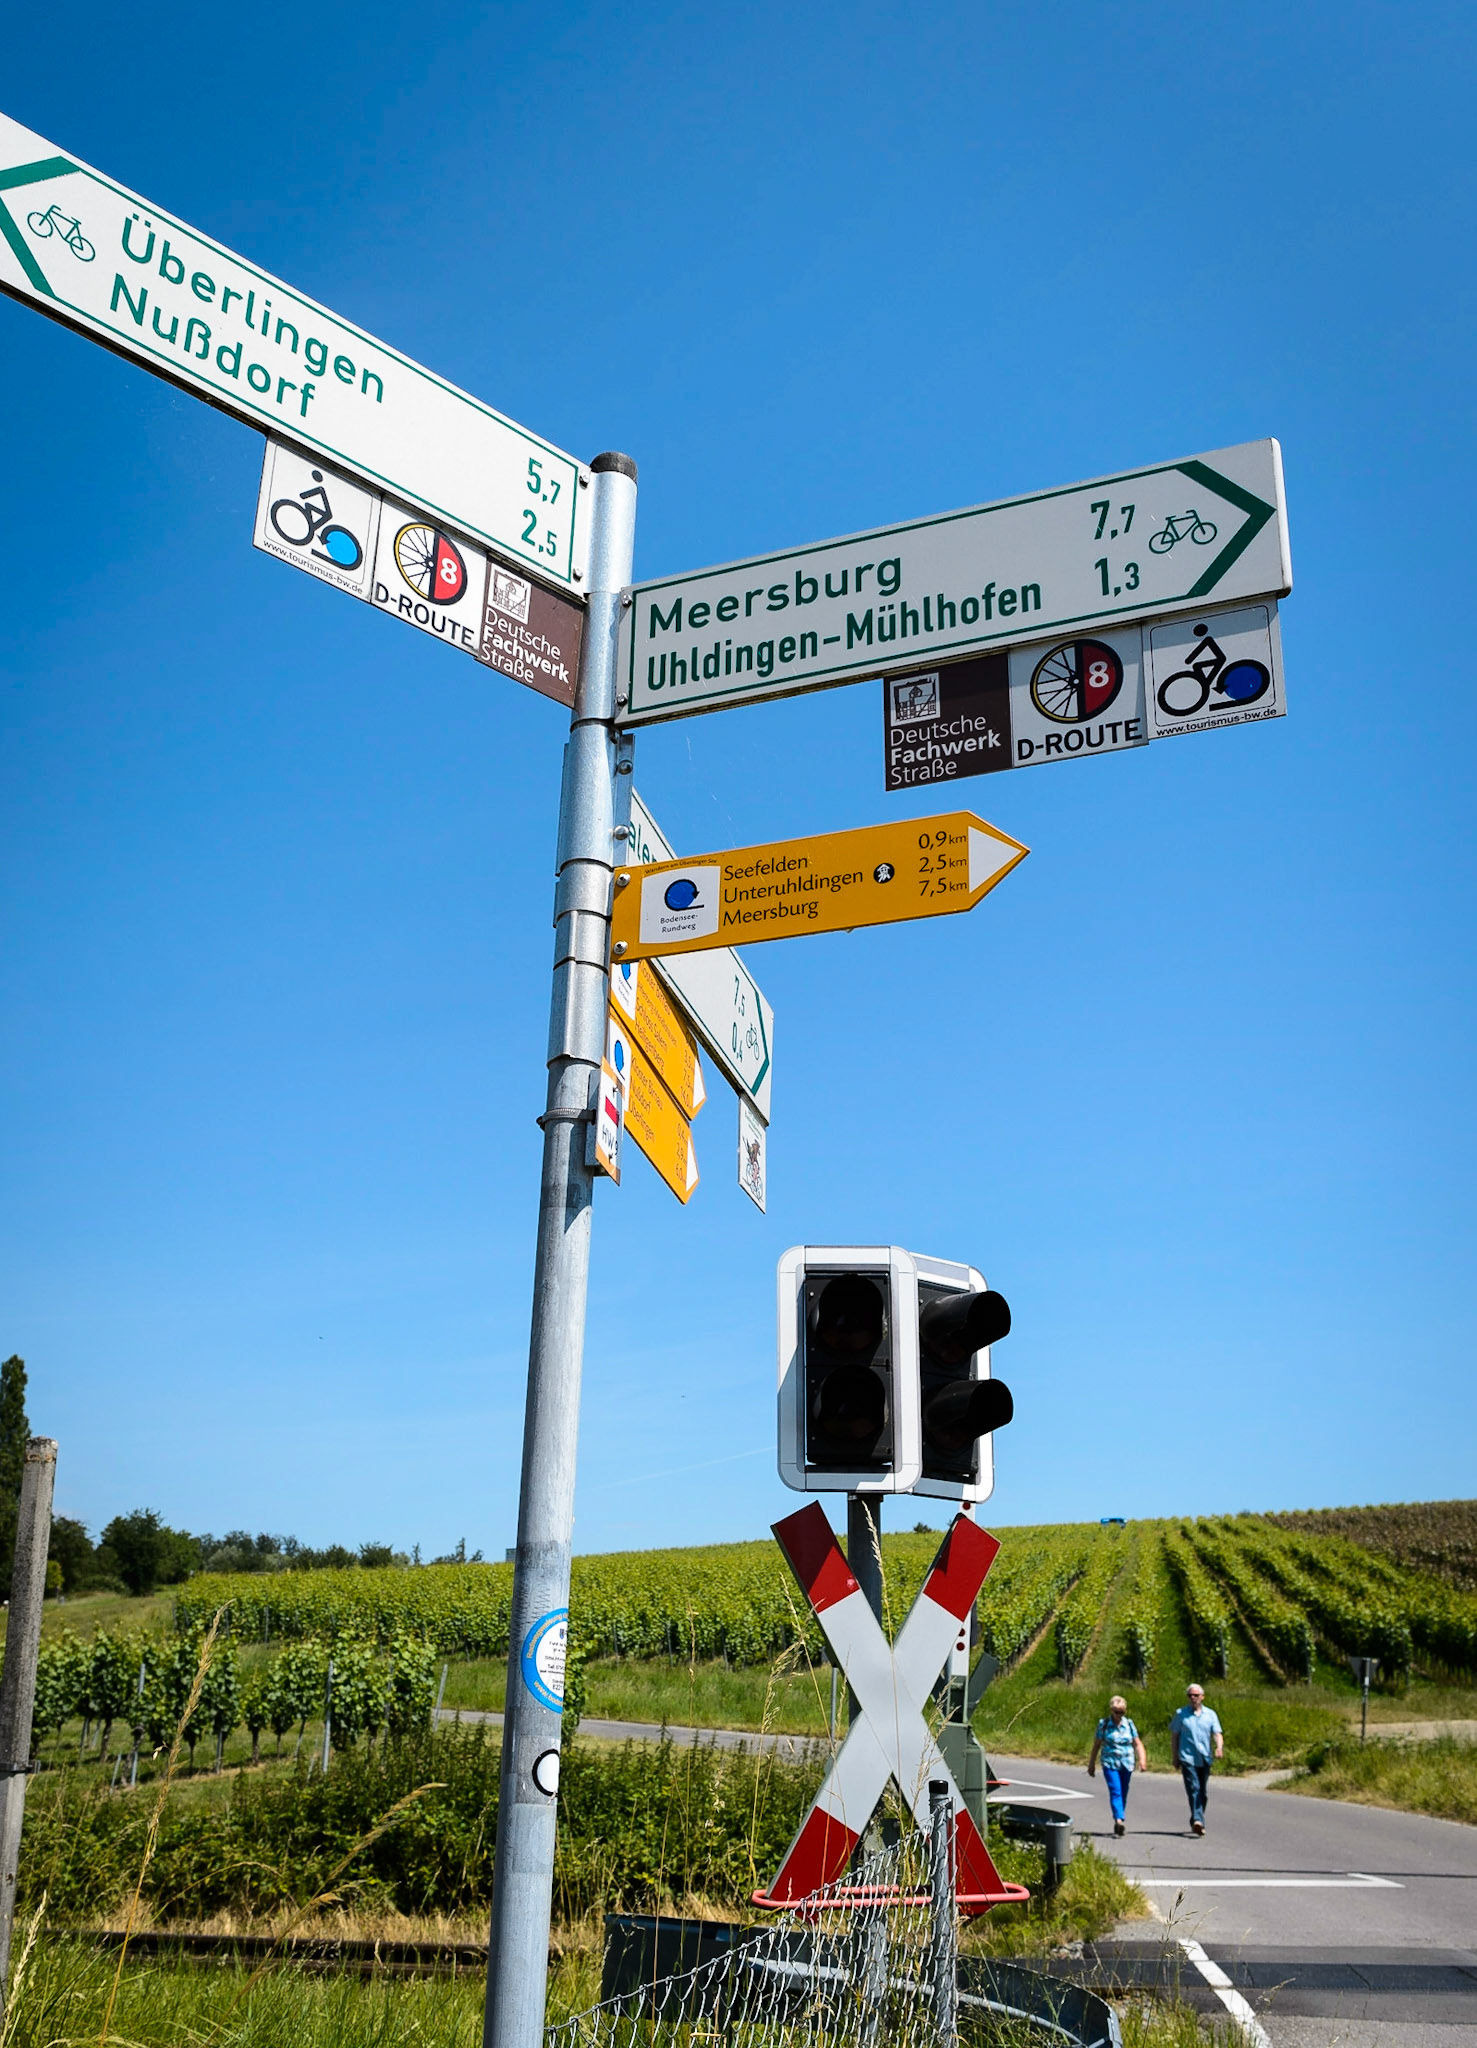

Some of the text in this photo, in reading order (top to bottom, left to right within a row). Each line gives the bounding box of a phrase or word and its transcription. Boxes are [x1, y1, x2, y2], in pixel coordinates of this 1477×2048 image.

[122, 214, 384, 403] Überlingen
[111, 272, 314, 417] Nußdorf
[527, 457, 561, 504] 5,7
[521, 509, 557, 557] 2,5
[1090, 500, 1136, 540] 7,7
[263, 540, 363, 594] www.tourismus-bw.de
[440, 557, 458, 585] 8
[1095, 559, 1140, 598] 1,3
[649, 554, 902, 638] Meersburg
[375, 582, 475, 649] D-ROUTE
[485, 606, 561, 660] Deutsche
[483, 626, 570, 683] Fachwerk
[647, 580, 1042, 692] Uhldingen-Mühlhofen
[481, 643, 535, 684] Straße
[1088, 660, 1109, 688] 8
[890, 714, 987, 747] Deutsche
[1017, 717, 1143, 761] D-ROUTE
[1156, 707, 1278, 737] www.tourismus-bw.de
[890, 730, 1002, 767] Fachwerk
[890, 758, 958, 786] Straße
[918, 831, 967, 850] 0,9 km
[723, 855, 808, 881] Seefelden
[918, 854, 967, 874] 2,5 km
[723, 870, 863, 904] Unteruhldingen
[918, 877, 968, 897] 7,5 km
[660, 914, 699, 925] Bodensee-
[661, 923, 697, 934] Rundweg
[722, 900, 819, 927] Meersburg
